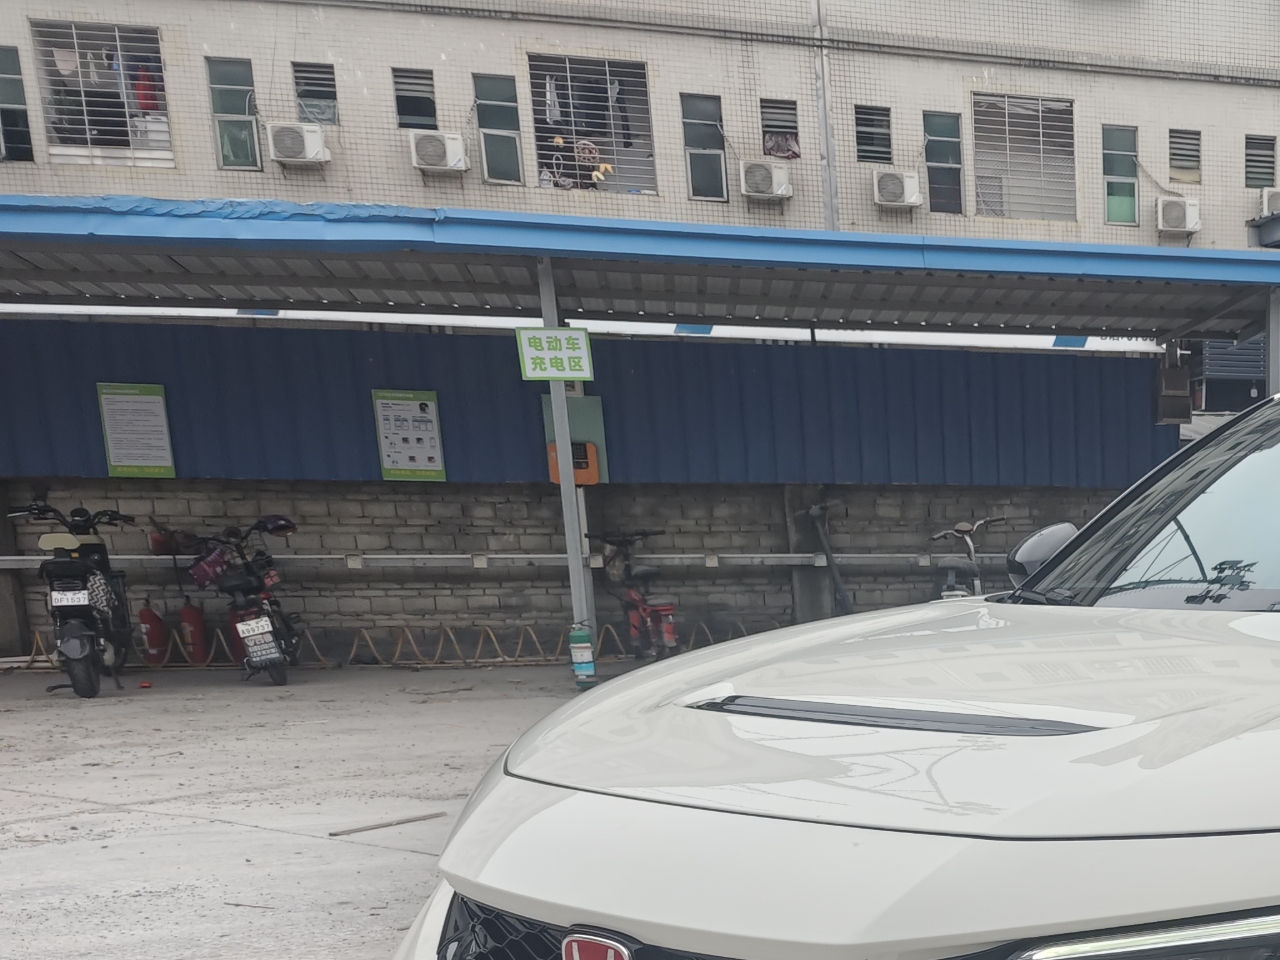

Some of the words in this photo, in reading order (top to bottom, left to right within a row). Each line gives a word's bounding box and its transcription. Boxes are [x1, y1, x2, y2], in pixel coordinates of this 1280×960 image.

[527, 335, 582, 352] 电动车
[530, 355, 584, 372] 充电区
[54, 596, 86, 604] DF1537
[241, 623, 270, 636] A99737
